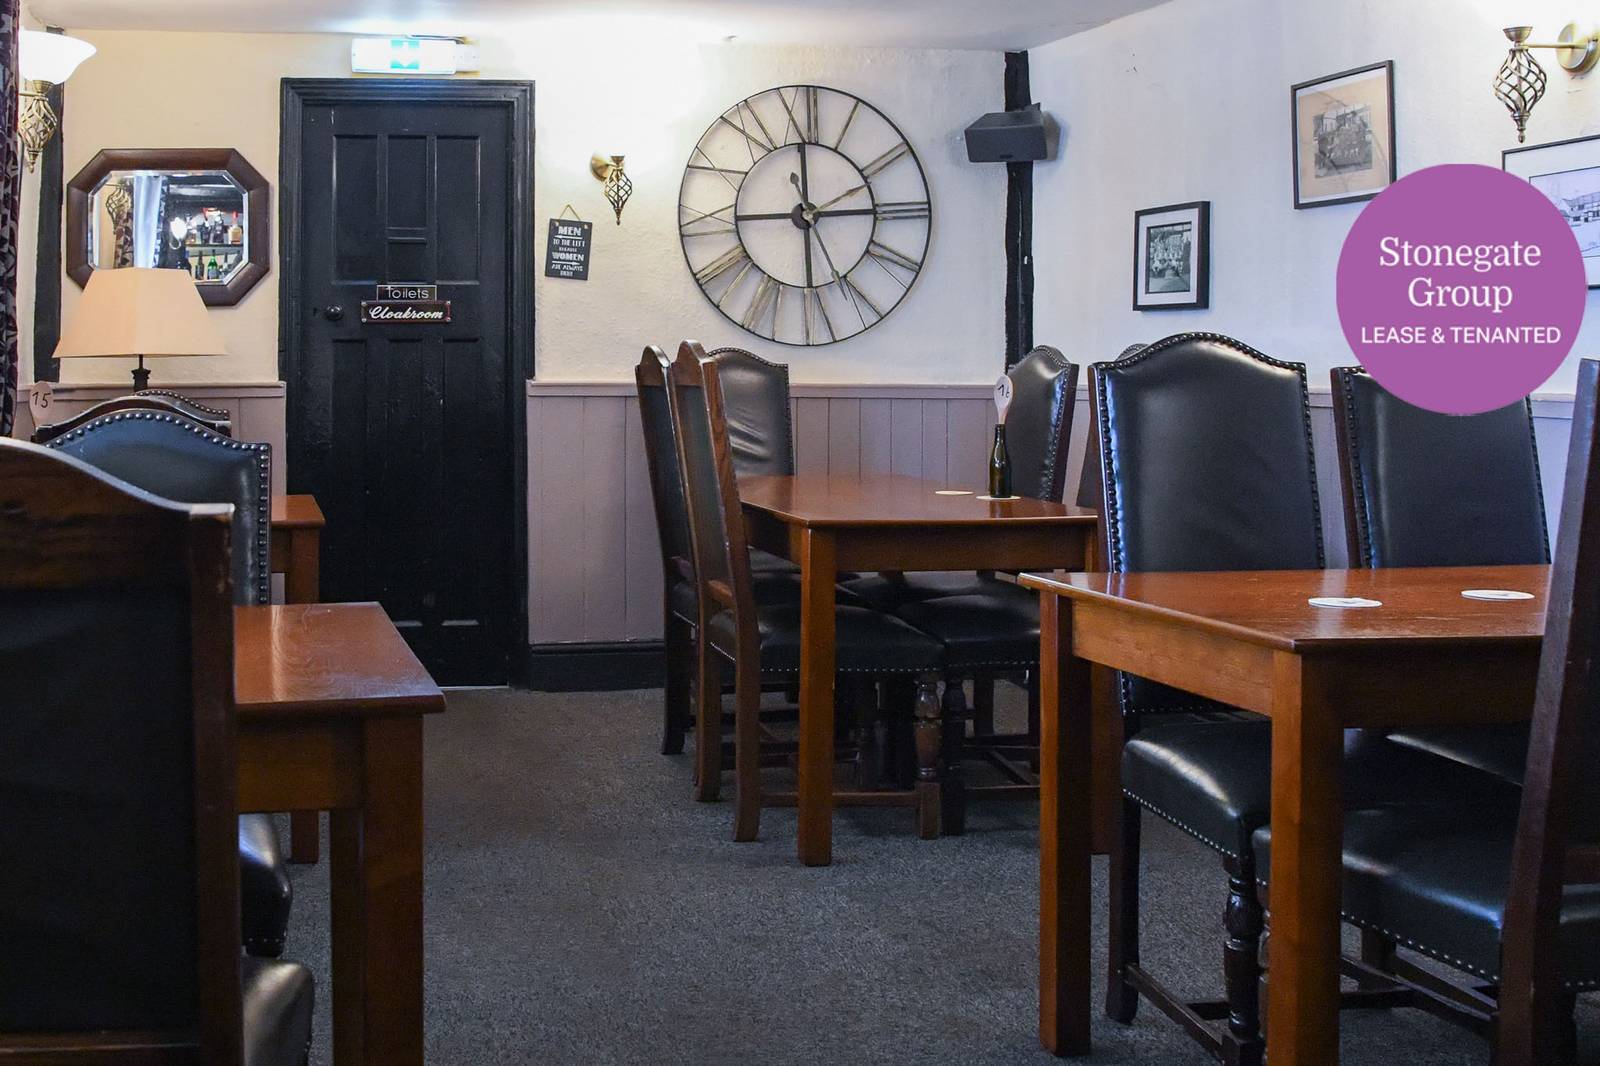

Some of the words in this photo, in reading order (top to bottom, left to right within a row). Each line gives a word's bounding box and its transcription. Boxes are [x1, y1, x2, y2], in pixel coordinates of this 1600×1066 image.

[558, 226, 581, 236] MEN
[552, 252, 584, 261] WOMEN
[386, 285, 429, 299] Toilets
[369, 305, 444, 319] Cloakroom
[32, 391, 51, 408] 15
